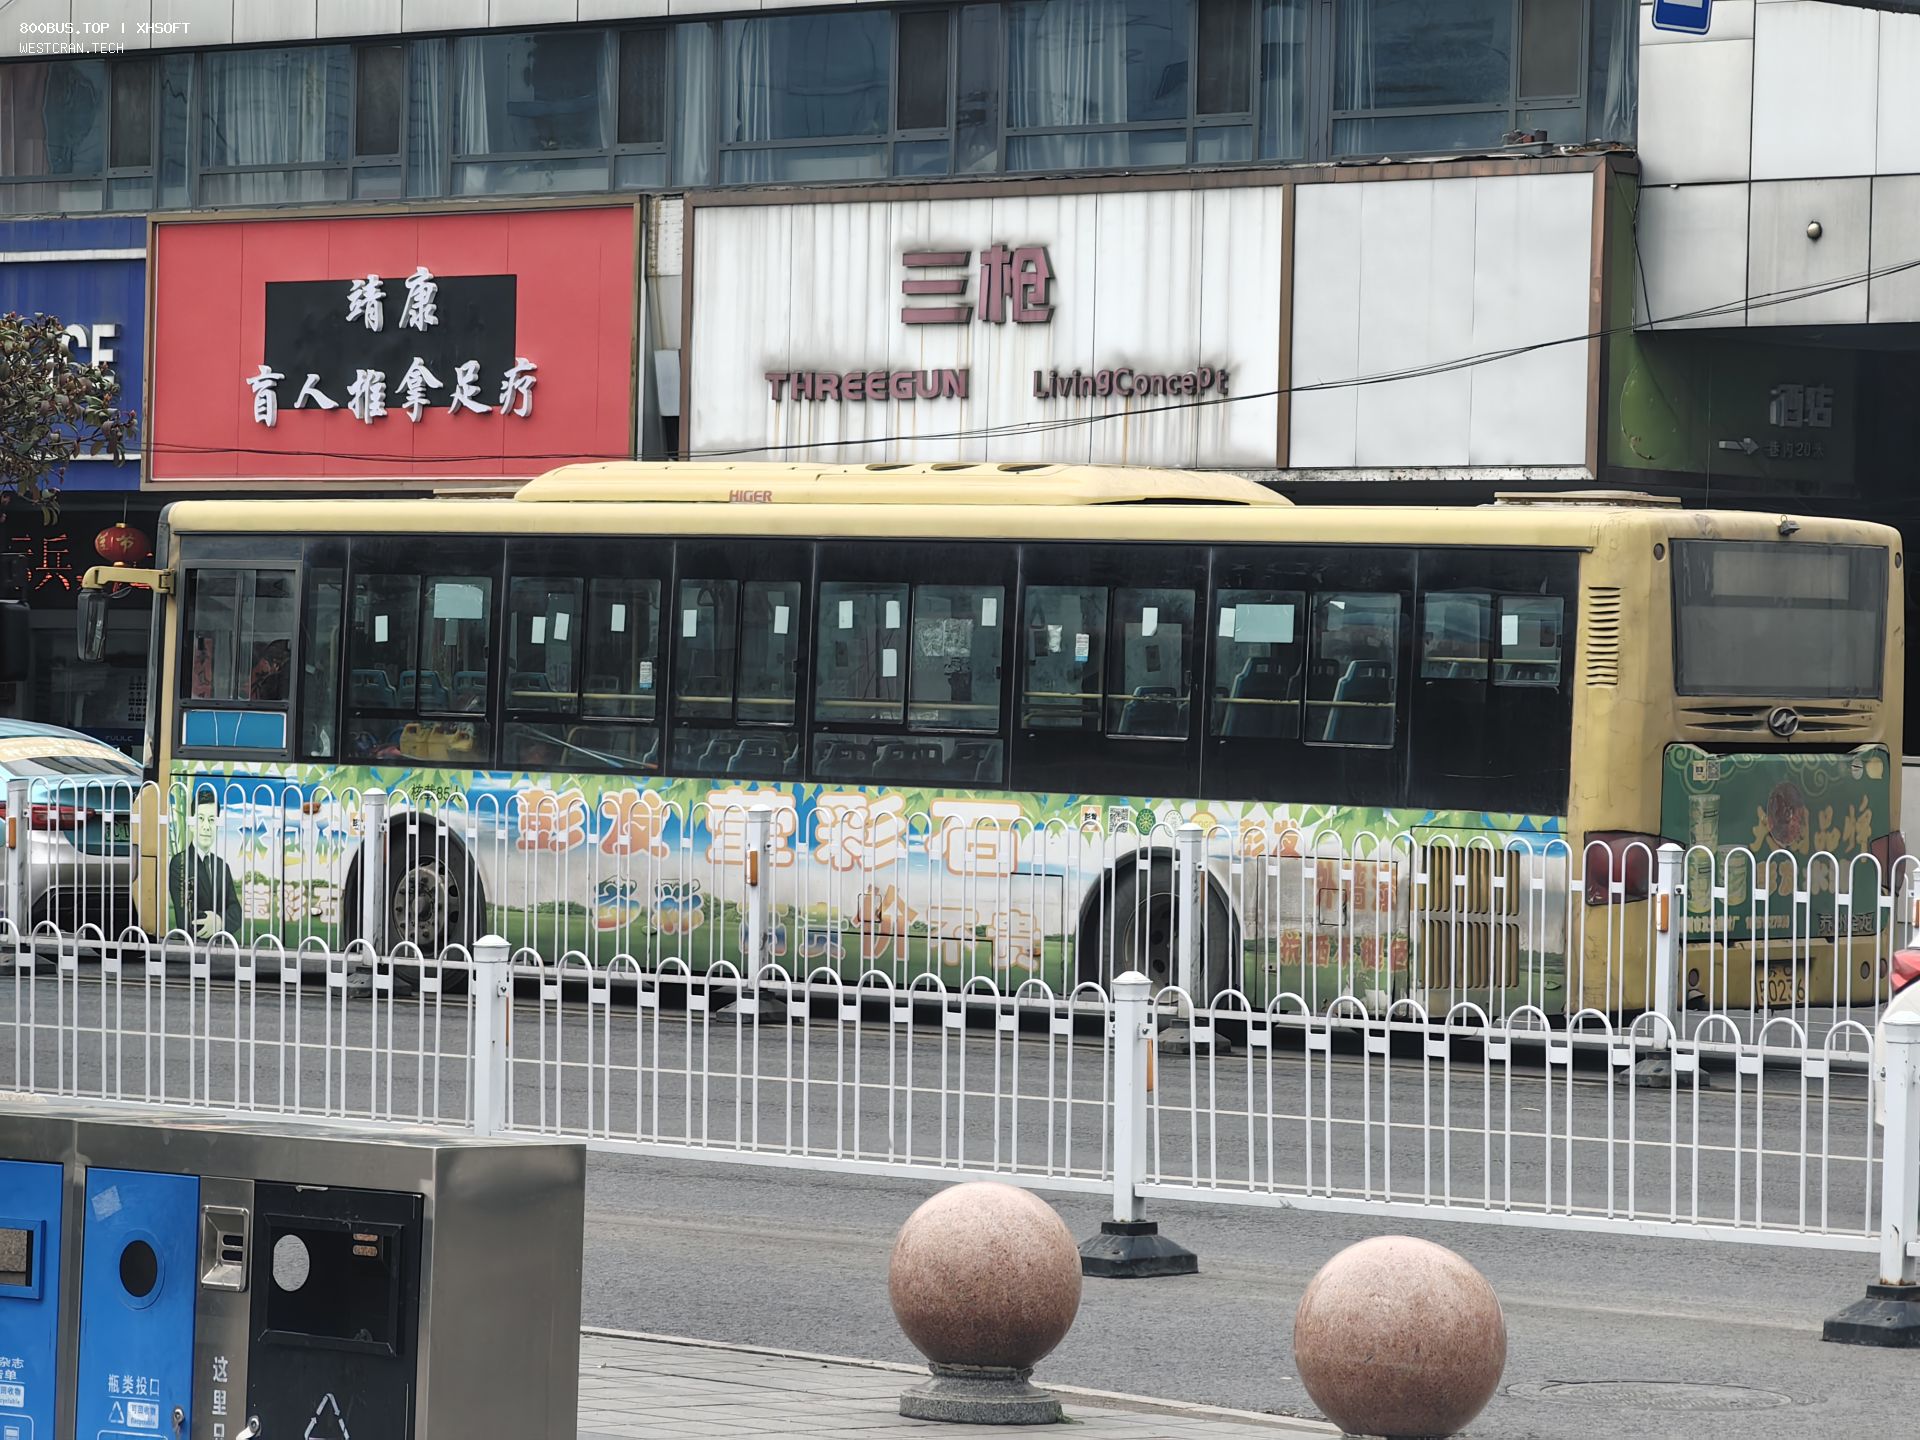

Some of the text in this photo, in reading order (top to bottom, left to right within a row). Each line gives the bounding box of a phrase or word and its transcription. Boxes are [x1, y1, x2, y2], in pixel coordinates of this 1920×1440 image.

[345, 266, 439, 332] 靖康
[901, 244, 1056, 325] 三枪
[246, 356, 538, 428] 盲人推拿足疗
[765, 368, 970, 401] THREEGUN
[1769, 384, 1834, 428] 酒店
[729, 489, 773, 503] HIGER
[108, 1374, 160, 1396] 瓶类投口
